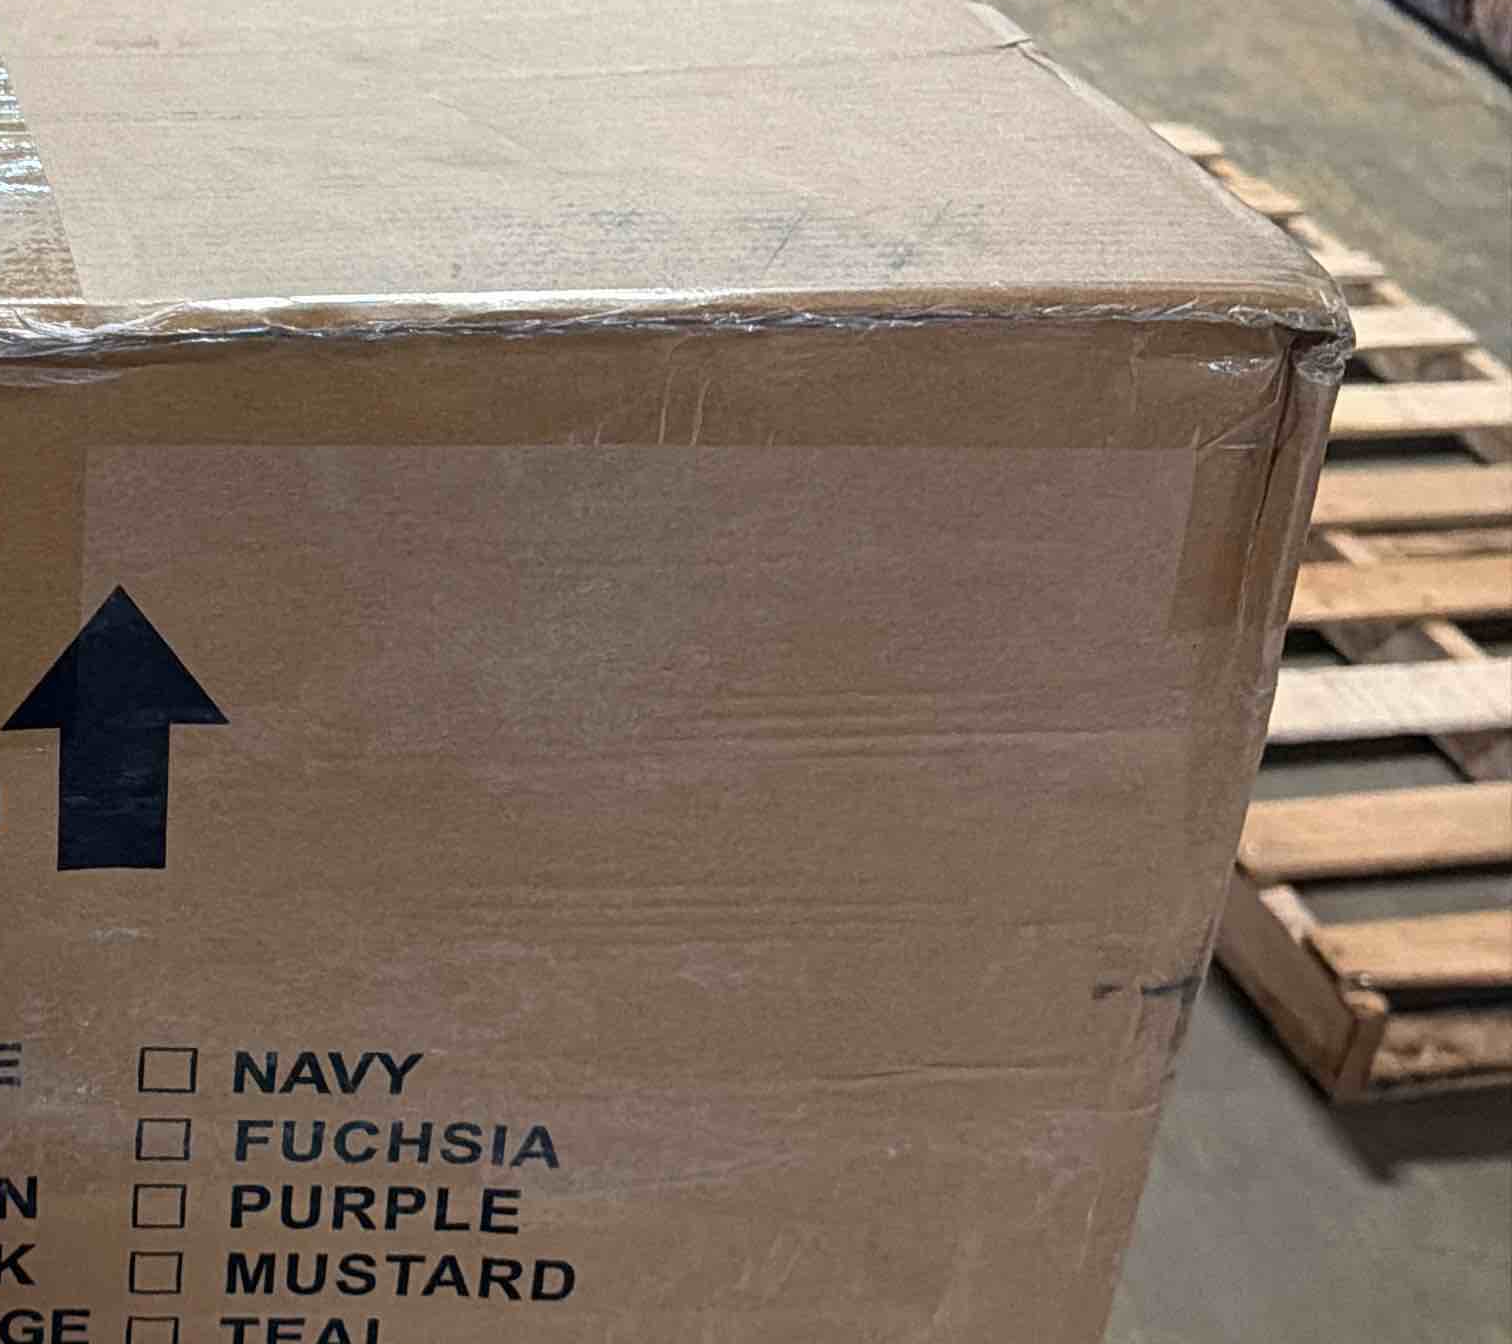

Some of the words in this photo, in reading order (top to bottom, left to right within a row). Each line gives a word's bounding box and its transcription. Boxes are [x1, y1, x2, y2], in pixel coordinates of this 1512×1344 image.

[233, 1051, 424, 1095] NAVY
[234, 1119, 559, 1169] FUCHSIA
[229, 1184, 521, 1235] PURPLE
[225, 1252, 575, 1301] MUSTARD
